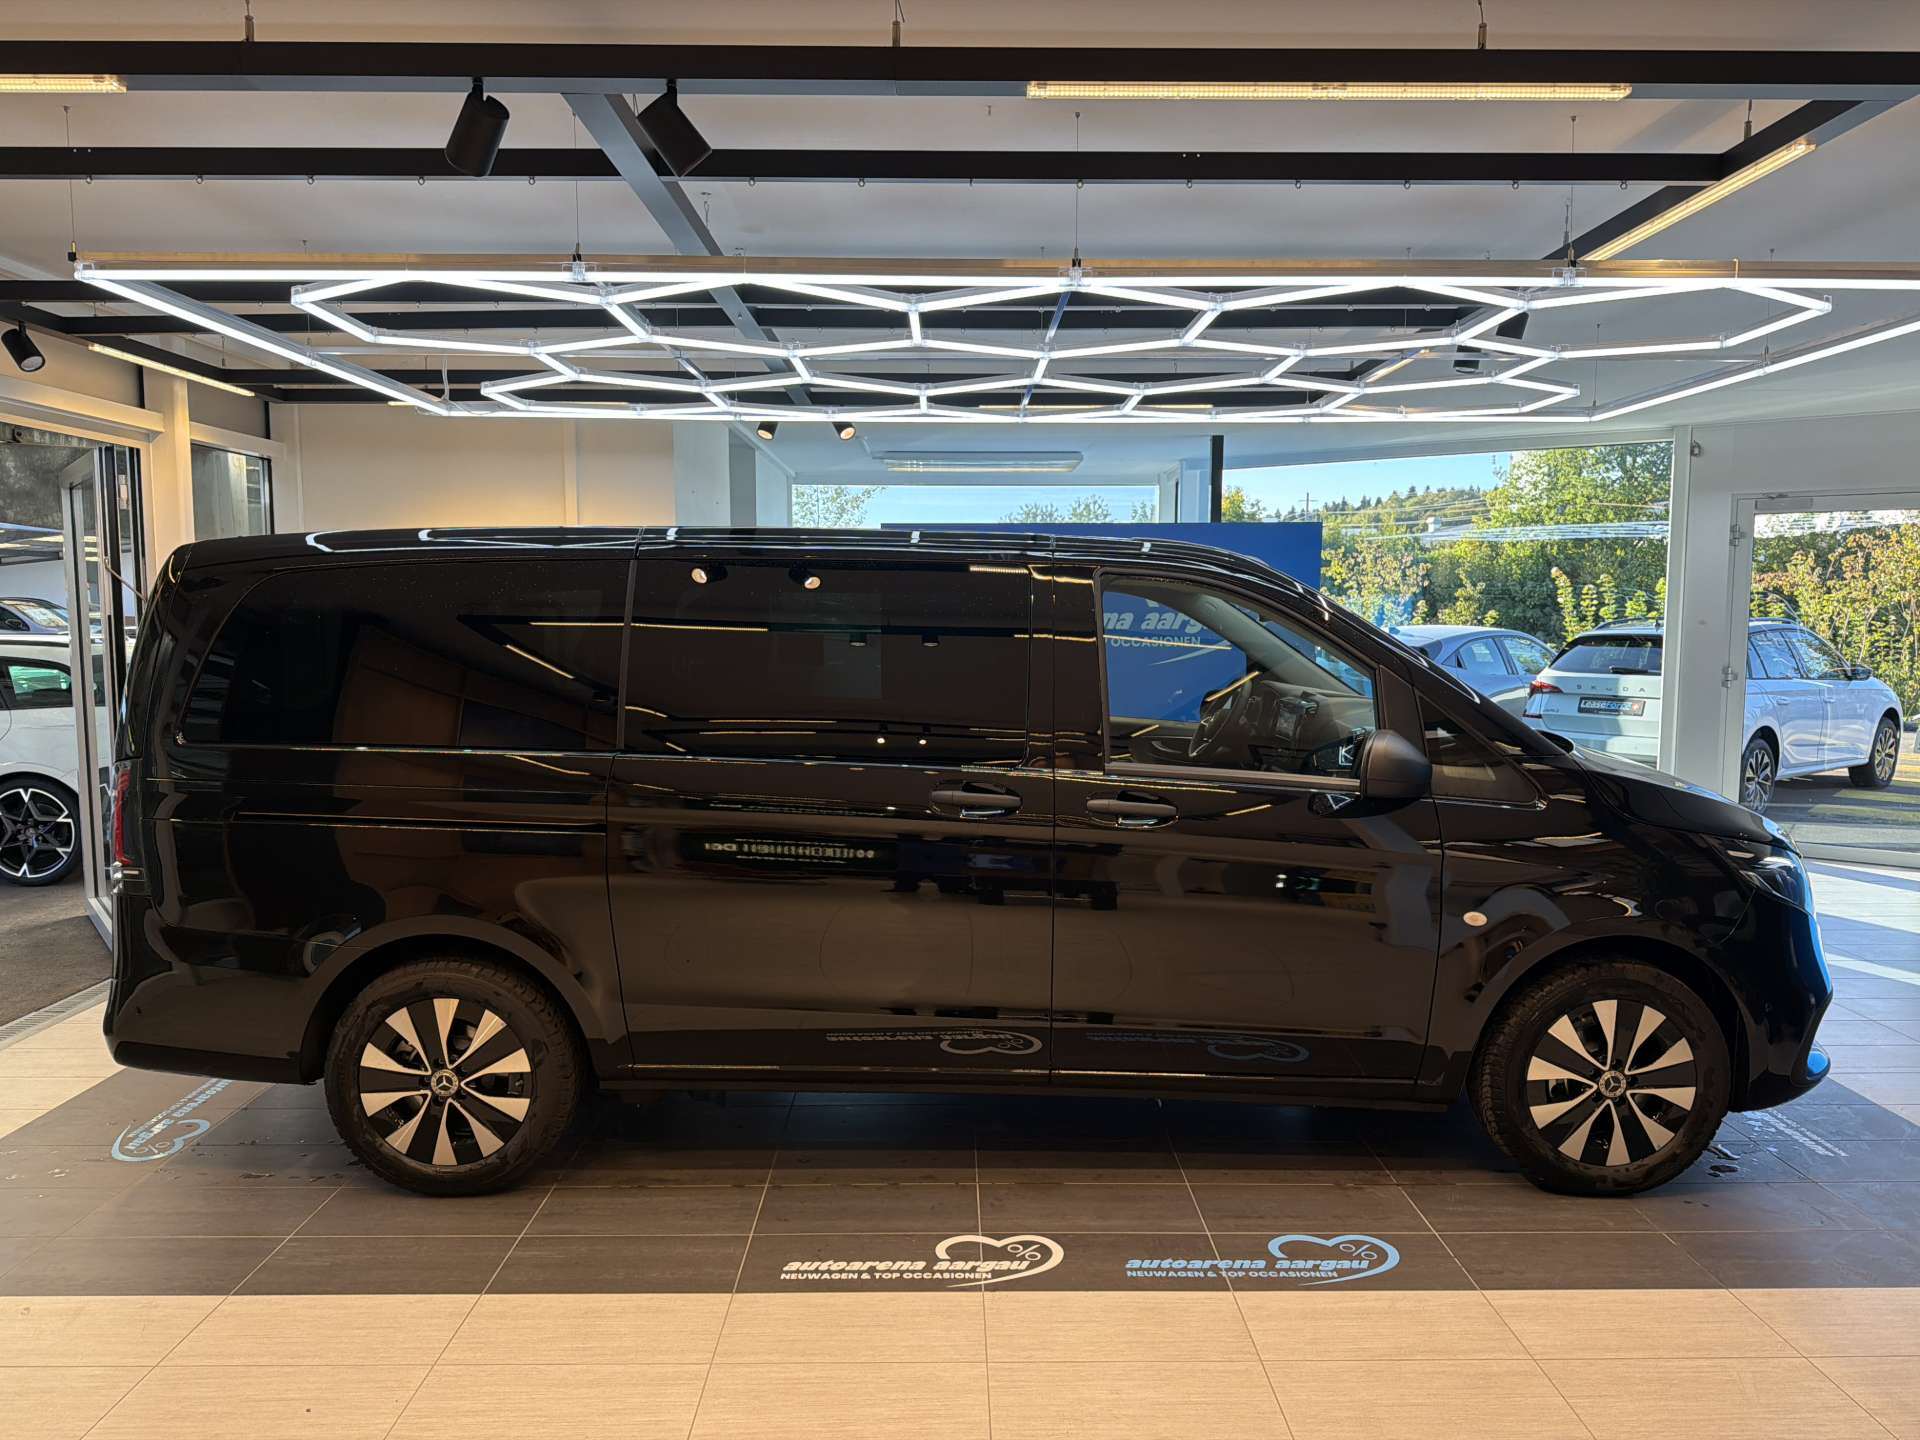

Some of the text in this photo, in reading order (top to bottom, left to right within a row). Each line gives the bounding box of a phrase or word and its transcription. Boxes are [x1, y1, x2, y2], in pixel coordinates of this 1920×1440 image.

[1103, 612, 1208, 634] na aarg
[1111, 636, 1201, 648] OCCASIONEN
[782, 1259, 1031, 1272] autoarena aargau
[1125, 1257, 1370, 1271] autoarena aargau
[780, 1272, 858, 1280] NEUWAGEN
[860, 1272, 871, 1280] &
[874, 1272, 901, 1280] TOP
[1126, 1270, 1205, 1278] NEUWAGEN
